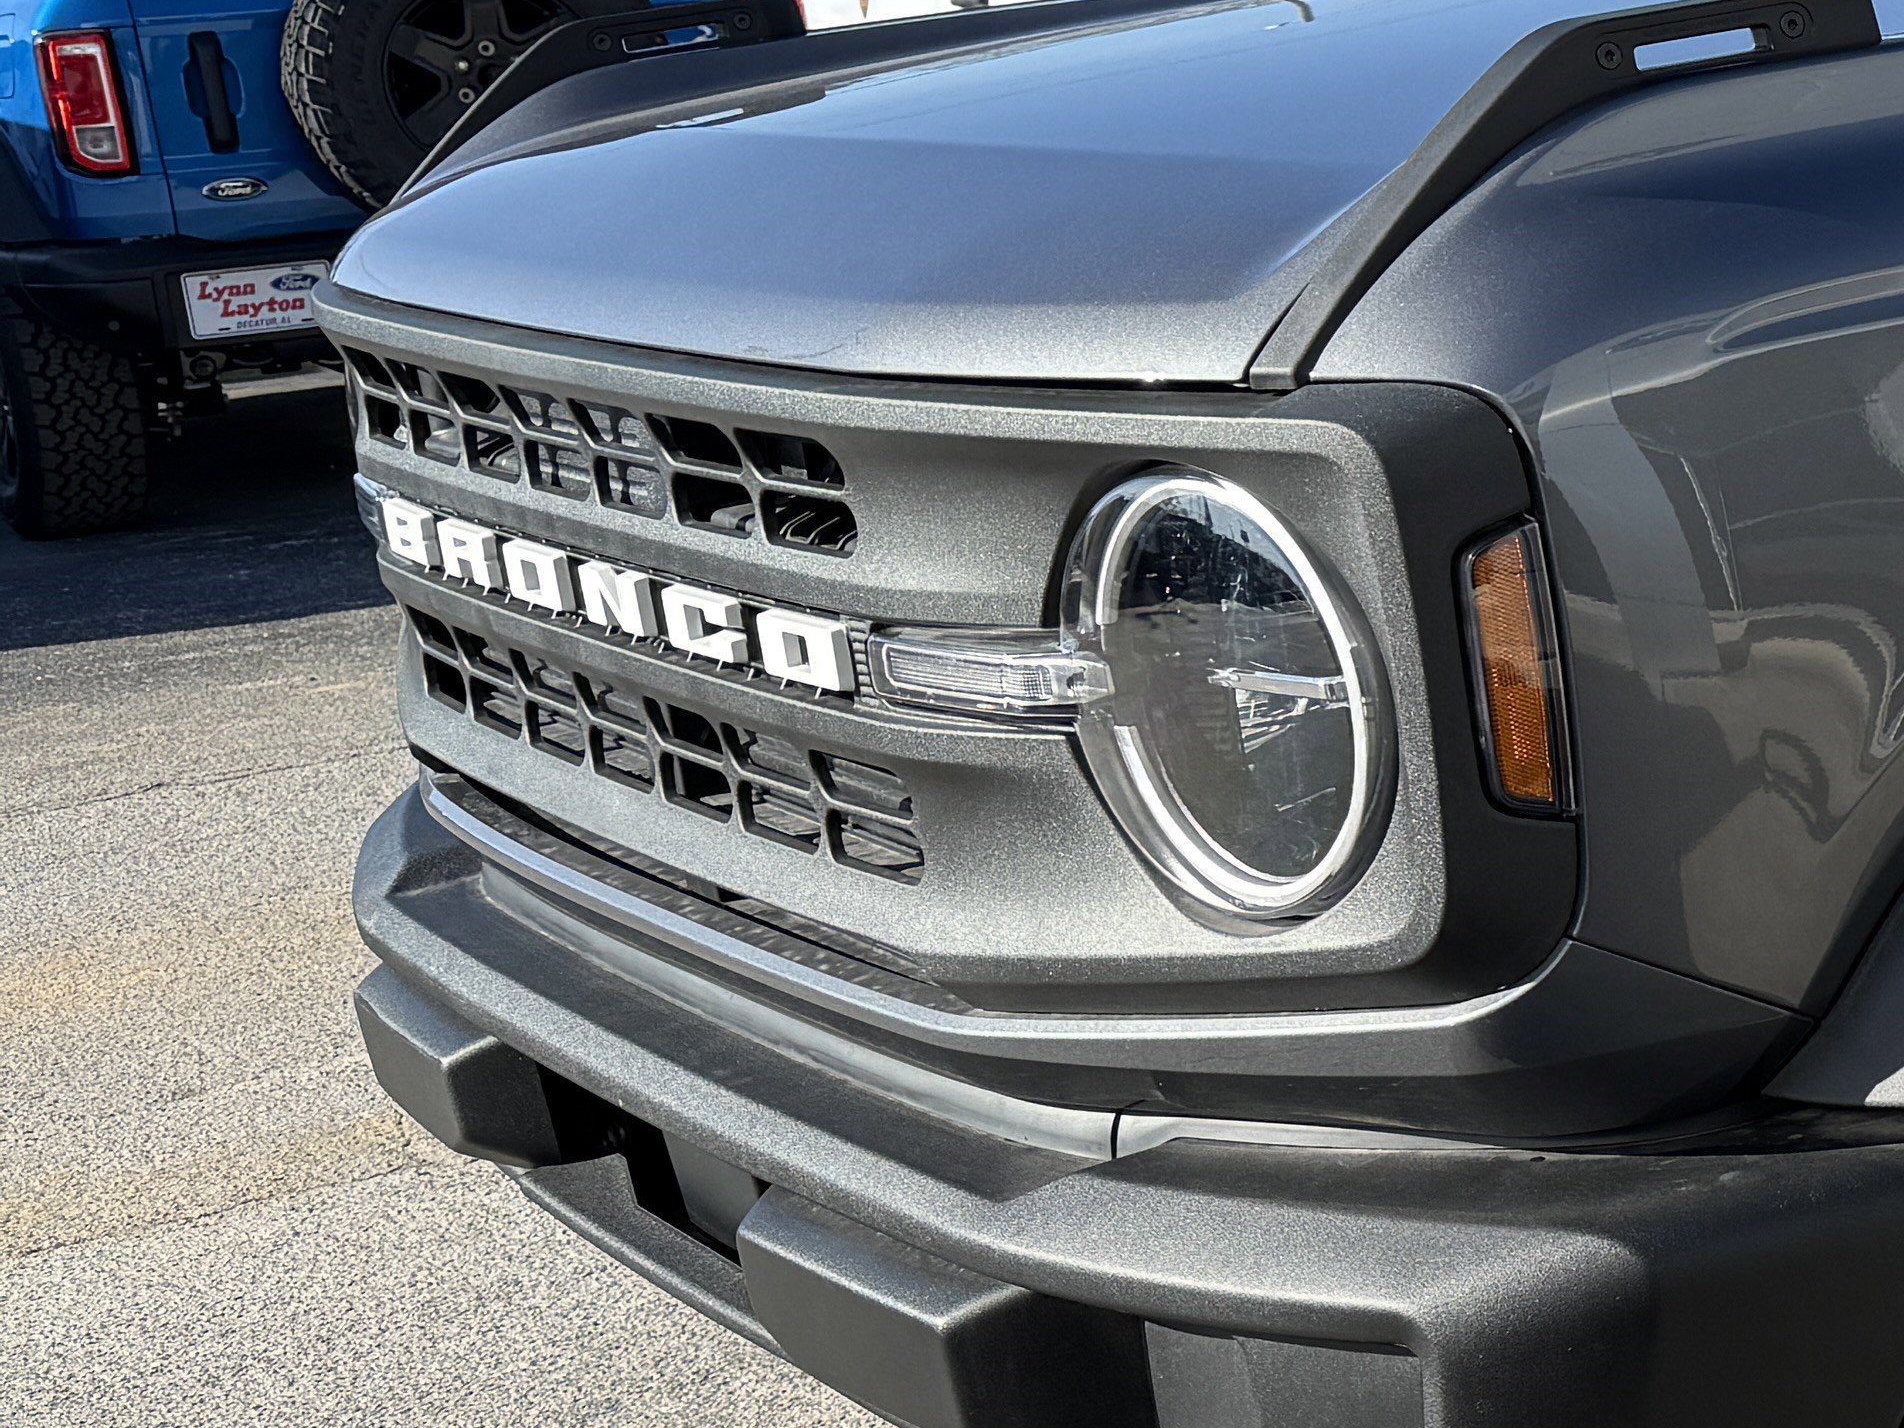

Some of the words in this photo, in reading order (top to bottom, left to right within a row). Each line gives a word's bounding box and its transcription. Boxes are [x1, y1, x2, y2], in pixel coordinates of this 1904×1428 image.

[217, 181, 252, 197] Ford
[197, 281, 257, 303] Lynn
[220, 296, 306, 319] Layton
[236, 316, 278, 329] DECATUR
[382, 497, 856, 693] BRONCO
